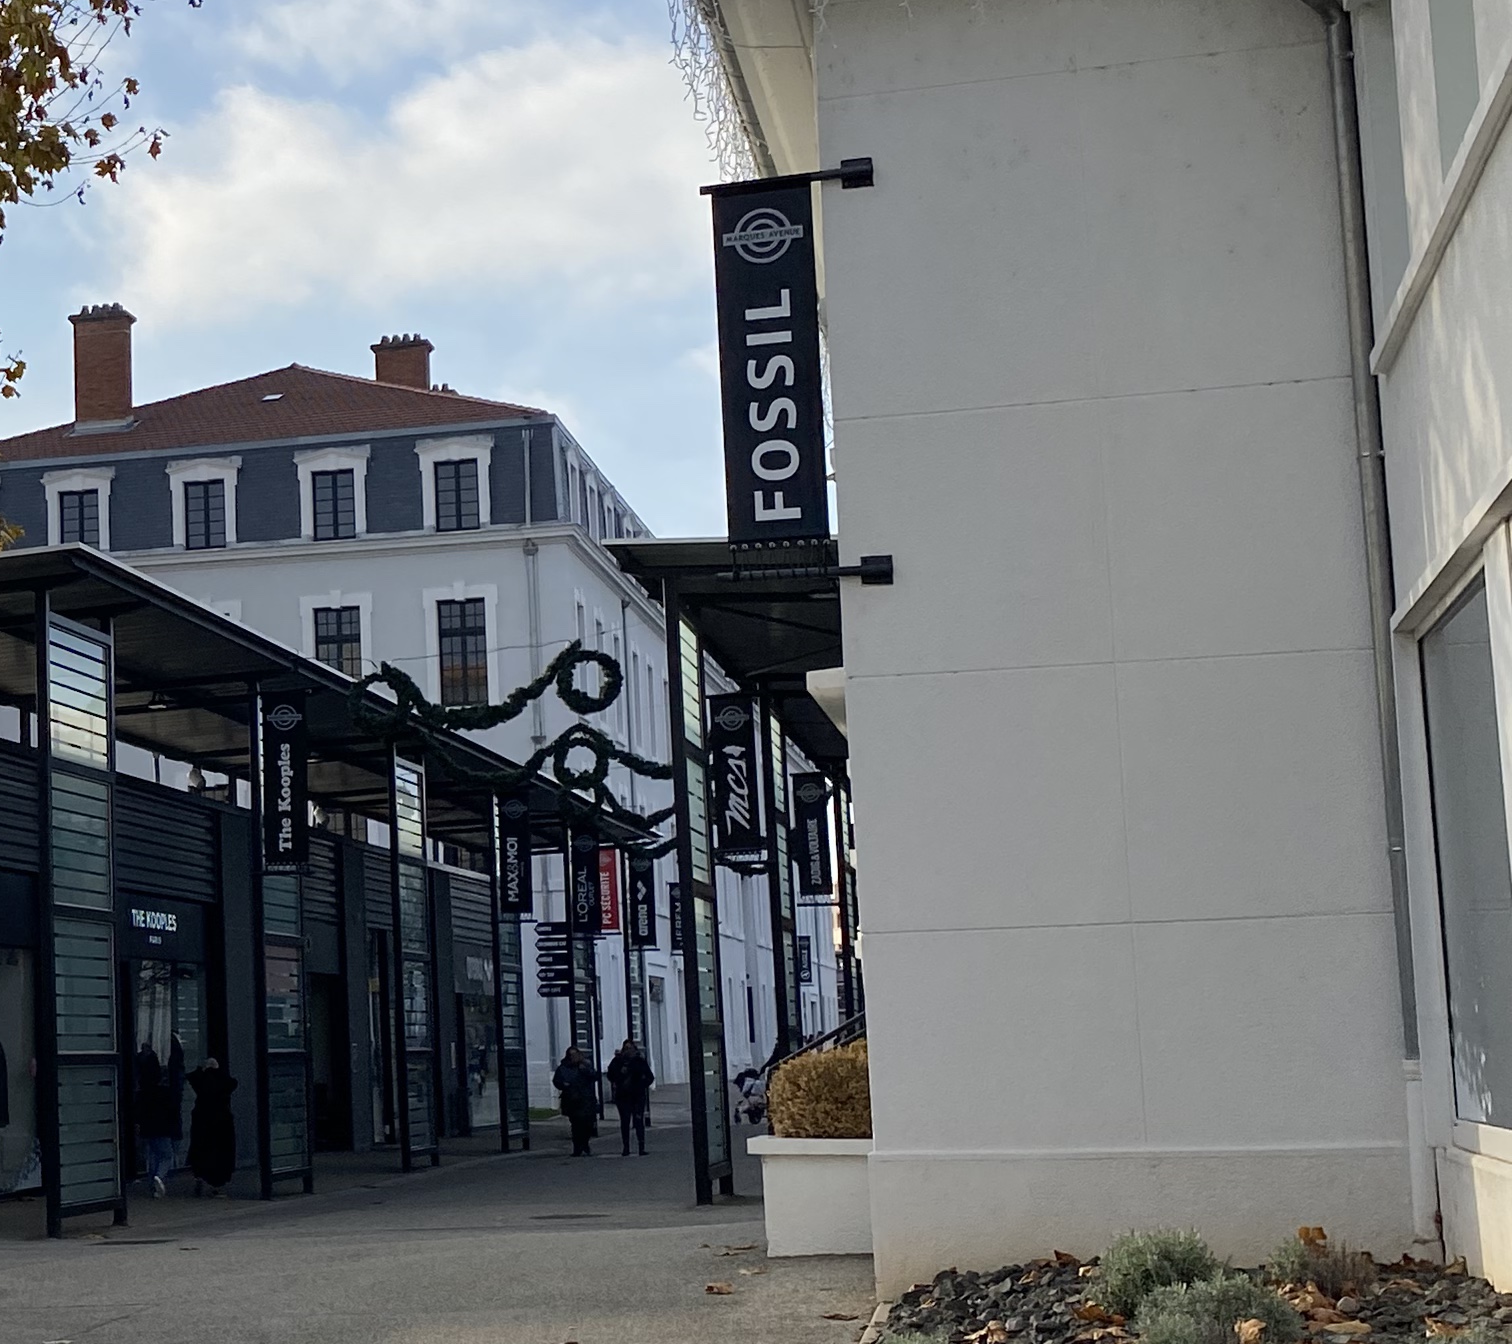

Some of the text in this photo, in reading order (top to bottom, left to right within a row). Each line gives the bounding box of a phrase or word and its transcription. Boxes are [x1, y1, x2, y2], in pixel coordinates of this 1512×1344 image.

[725, 226, 800, 243] MARQUES AVENUE
[744, 288, 802, 522] FOSSIL
[278, 742, 294, 852] The Kooples
[131, 908, 178, 932] THE KOOPLES
[601, 912, 613, 925] PC
[637, 903, 649, 937] arena
